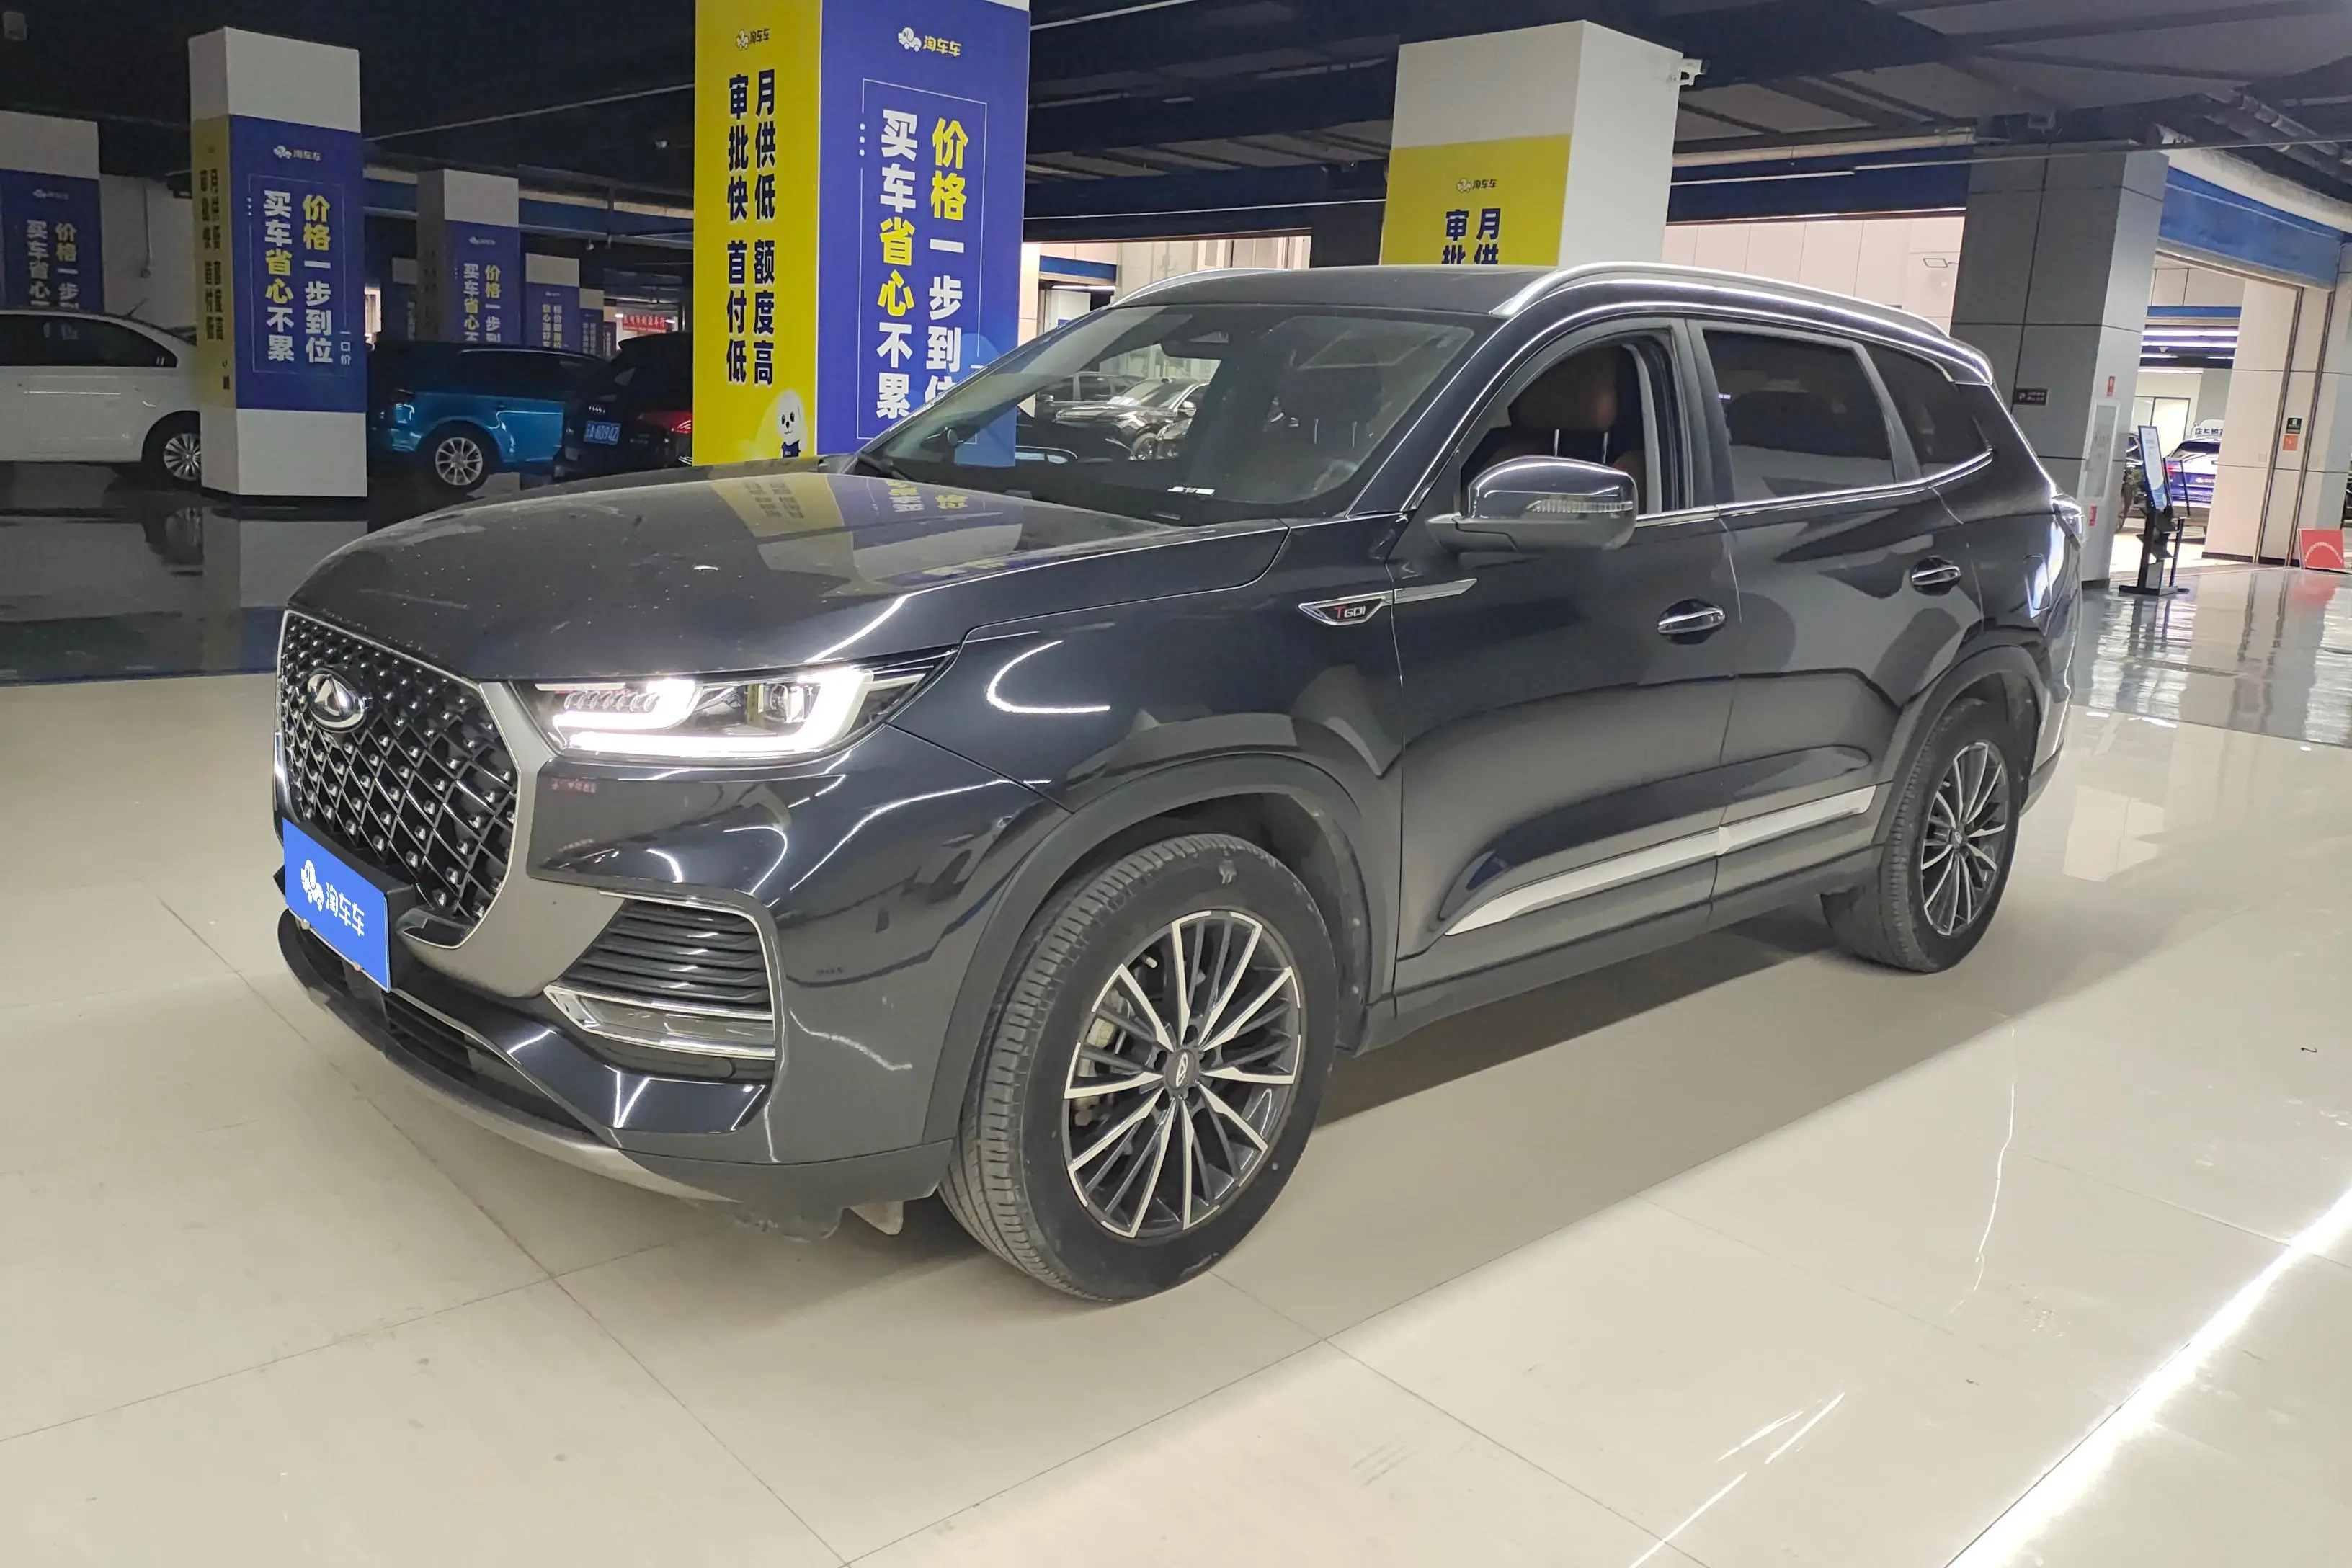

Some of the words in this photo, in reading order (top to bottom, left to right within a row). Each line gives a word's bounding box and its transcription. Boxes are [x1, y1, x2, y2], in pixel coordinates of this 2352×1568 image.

[749, 28, 770, 44] 淘车车
[923, 35, 962, 57] 淘车车
[726, 74, 749, 221] 审批快
[755, 68, 777, 220] 月供低
[1471, 179, 1497, 190] 淘车车
[27, 219, 50, 306] 买车省心
[264, 190, 295, 362] 买车省心不累
[302, 194, 333, 363] 价格一步到位
[876, 109, 917, 419] 买车省心不累
[1474, 208, 1501, 264] 月供
[339, 331, 351, 365] 一口价
[726, 239, 748, 383] 首付低
[753, 239, 775, 386] 额度高
[326, 881, 365, 937] 淘车车
